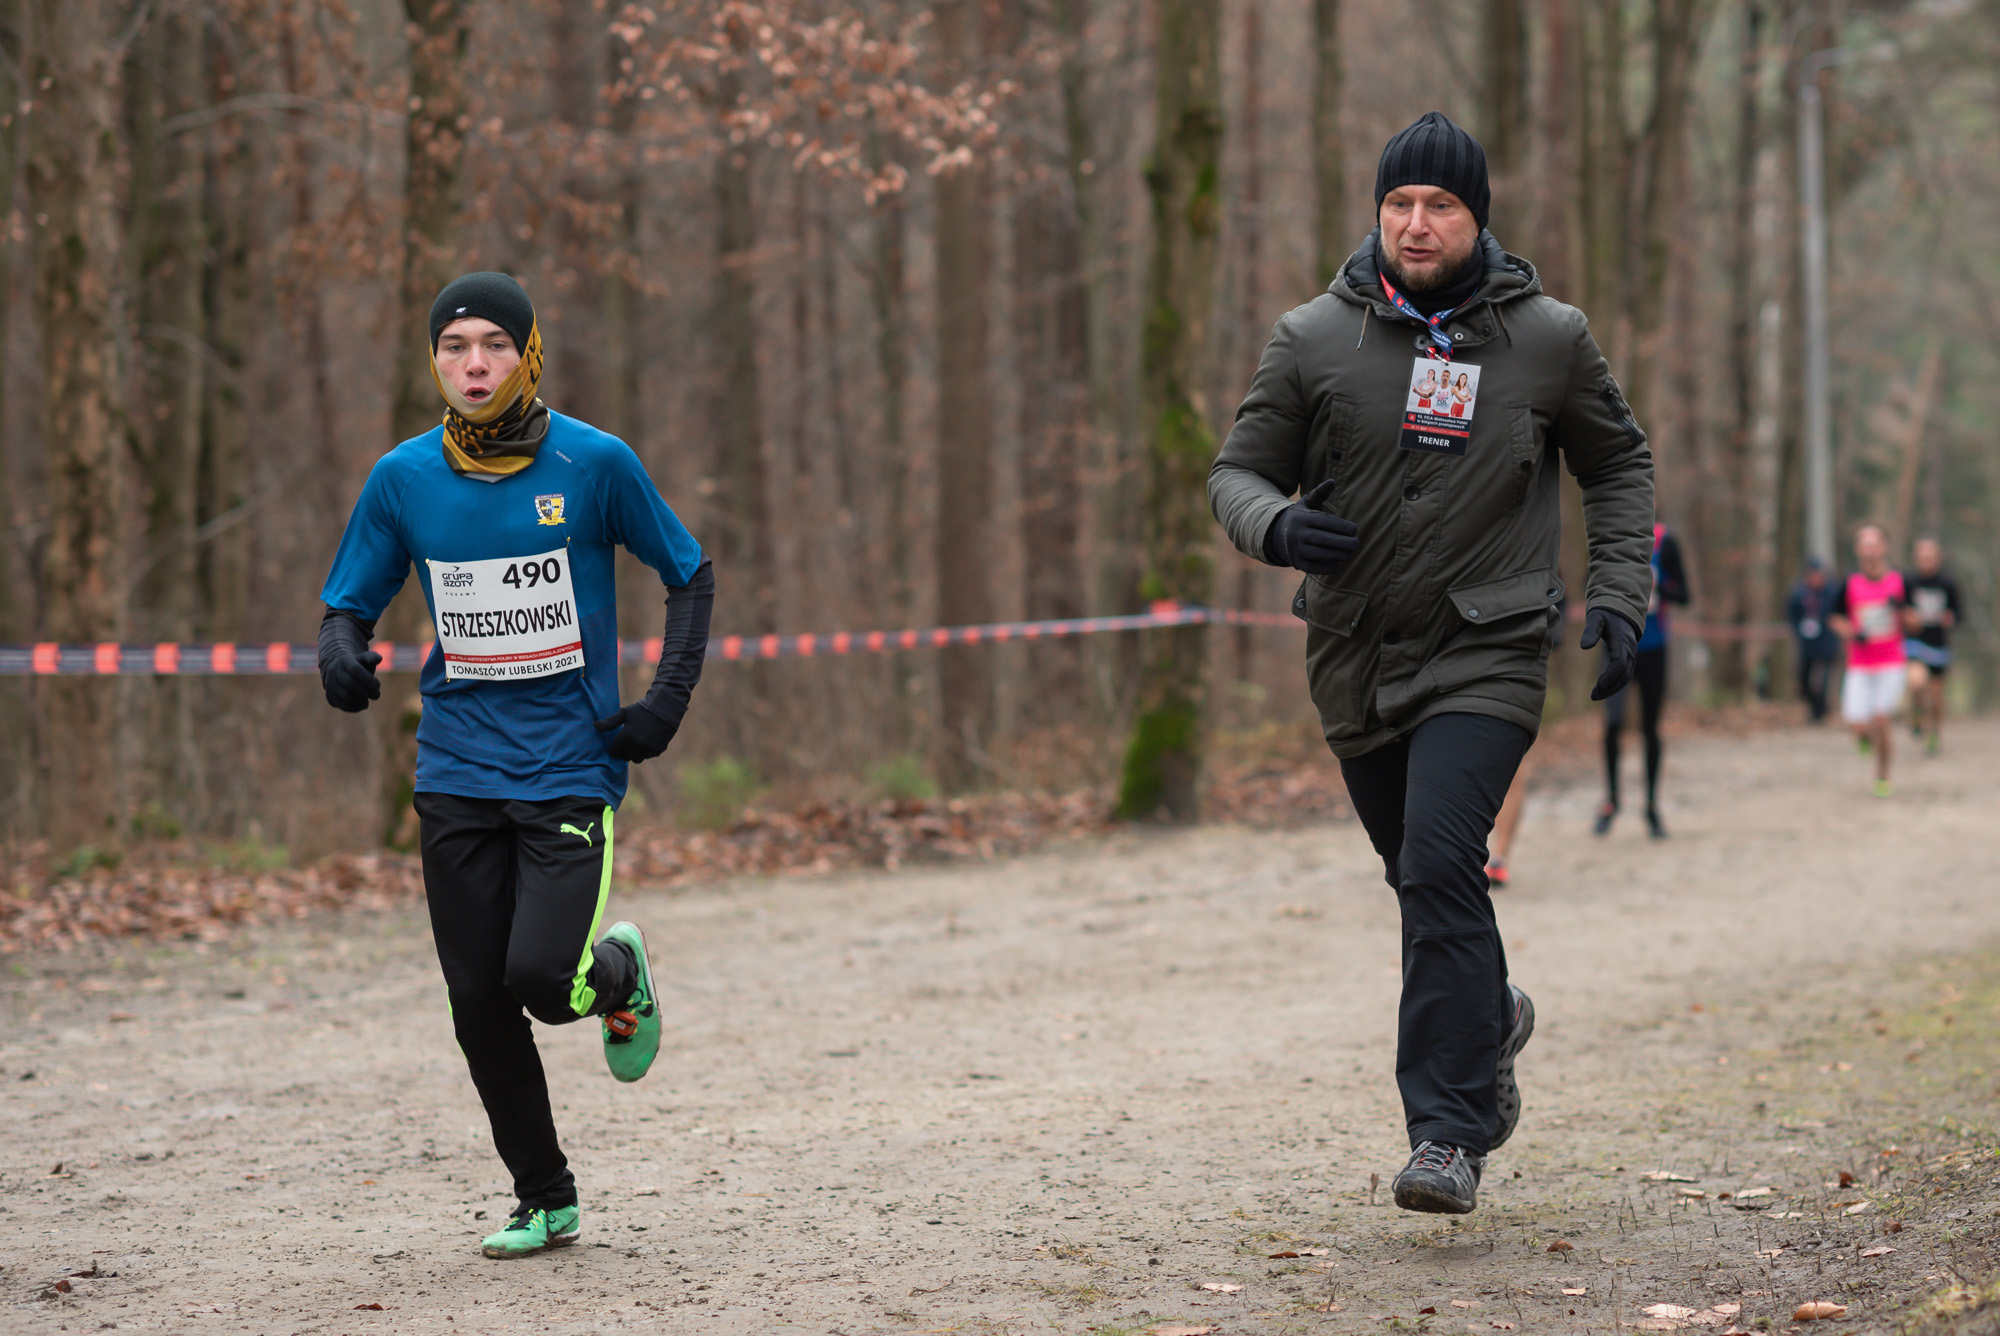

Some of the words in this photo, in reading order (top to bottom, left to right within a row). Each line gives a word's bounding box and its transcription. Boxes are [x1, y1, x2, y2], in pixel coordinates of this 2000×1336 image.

[1418, 435, 1450, 447] TRENER
[501, 557, 561, 589] 490
[441, 599, 572, 638] STRZESZKOWSKI
[451, 665, 506, 677] TOMASZÓW
[508, 661, 553, 676] LUBELSKI
[554, 654, 577, 669] 2021
